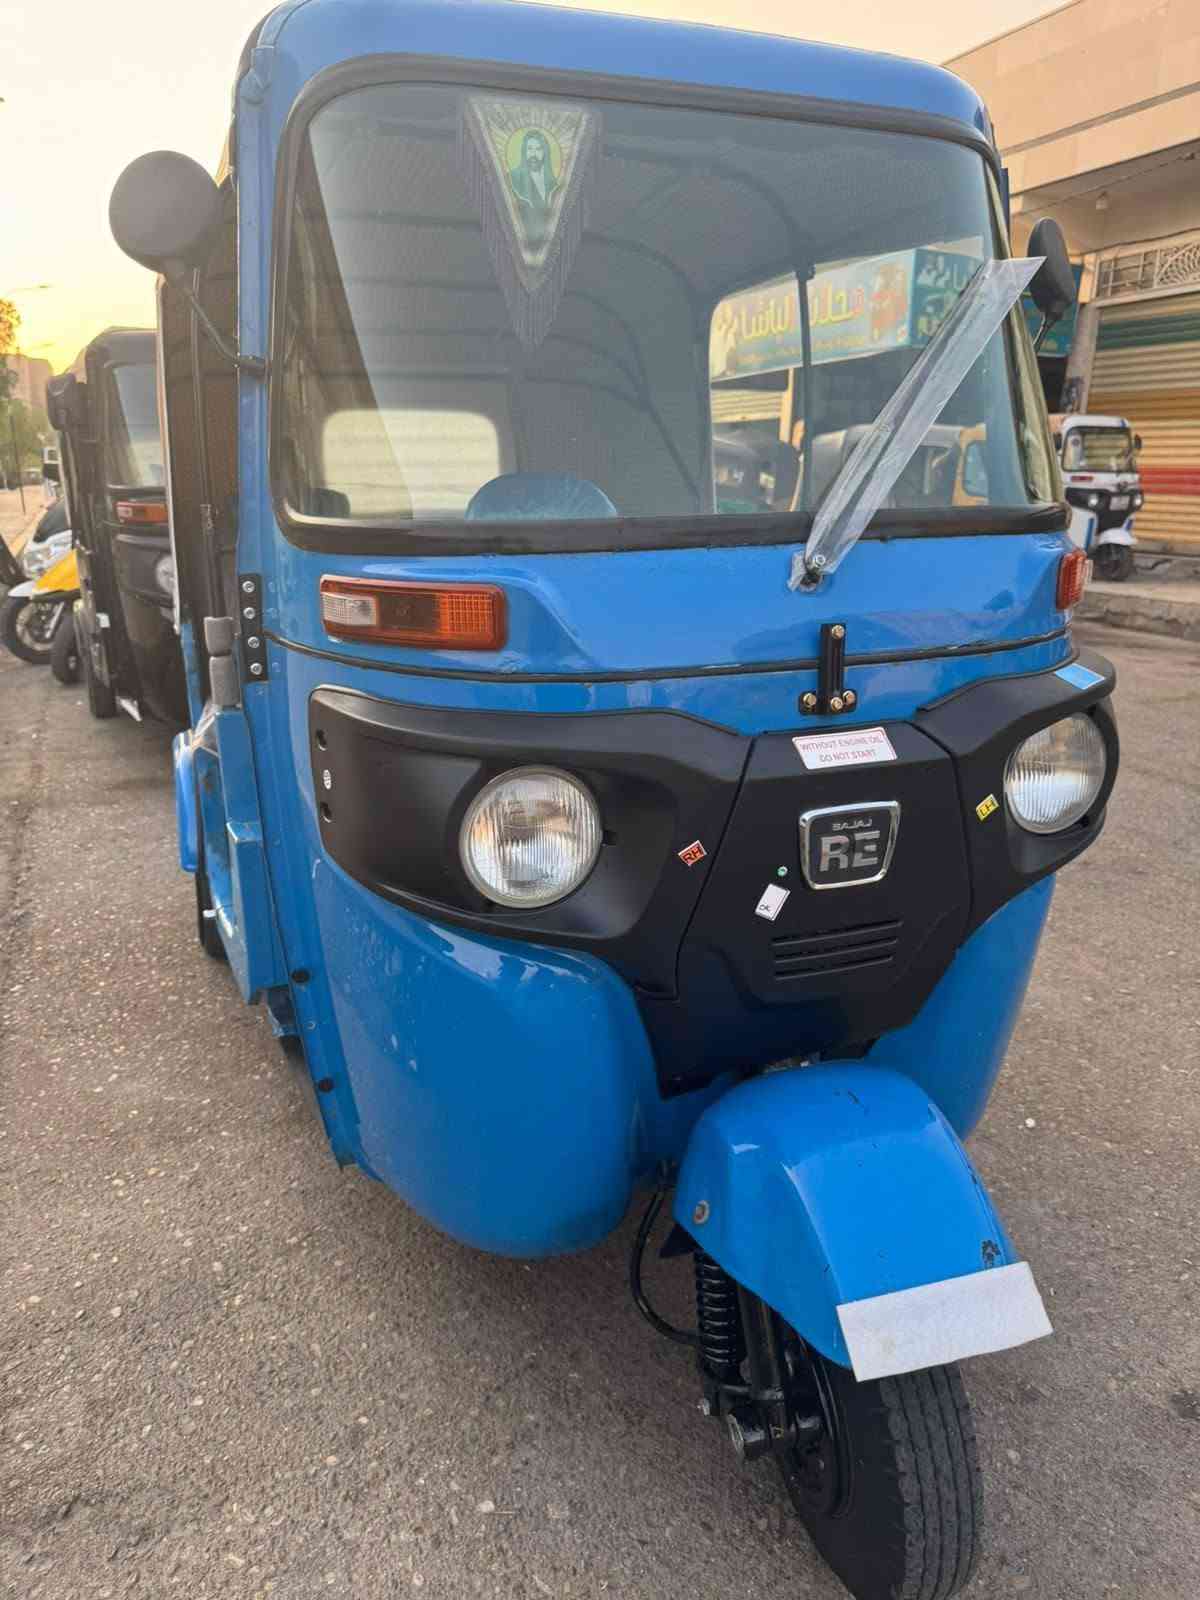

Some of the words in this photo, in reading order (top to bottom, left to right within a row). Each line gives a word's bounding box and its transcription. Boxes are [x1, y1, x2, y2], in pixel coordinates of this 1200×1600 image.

[800, 739, 837, 752] WITHOUT
[838, 736, 870, 747] ENGINE
[870, 733, 884, 744] OIL
[819, 752, 832, 763] DO
[832, 750, 850, 762] NOT
[851, 748, 877, 760] START
[832, 818, 873, 831] BAJAJ
[682, 845, 704, 862] RH
[820, 830, 881, 872] RE
